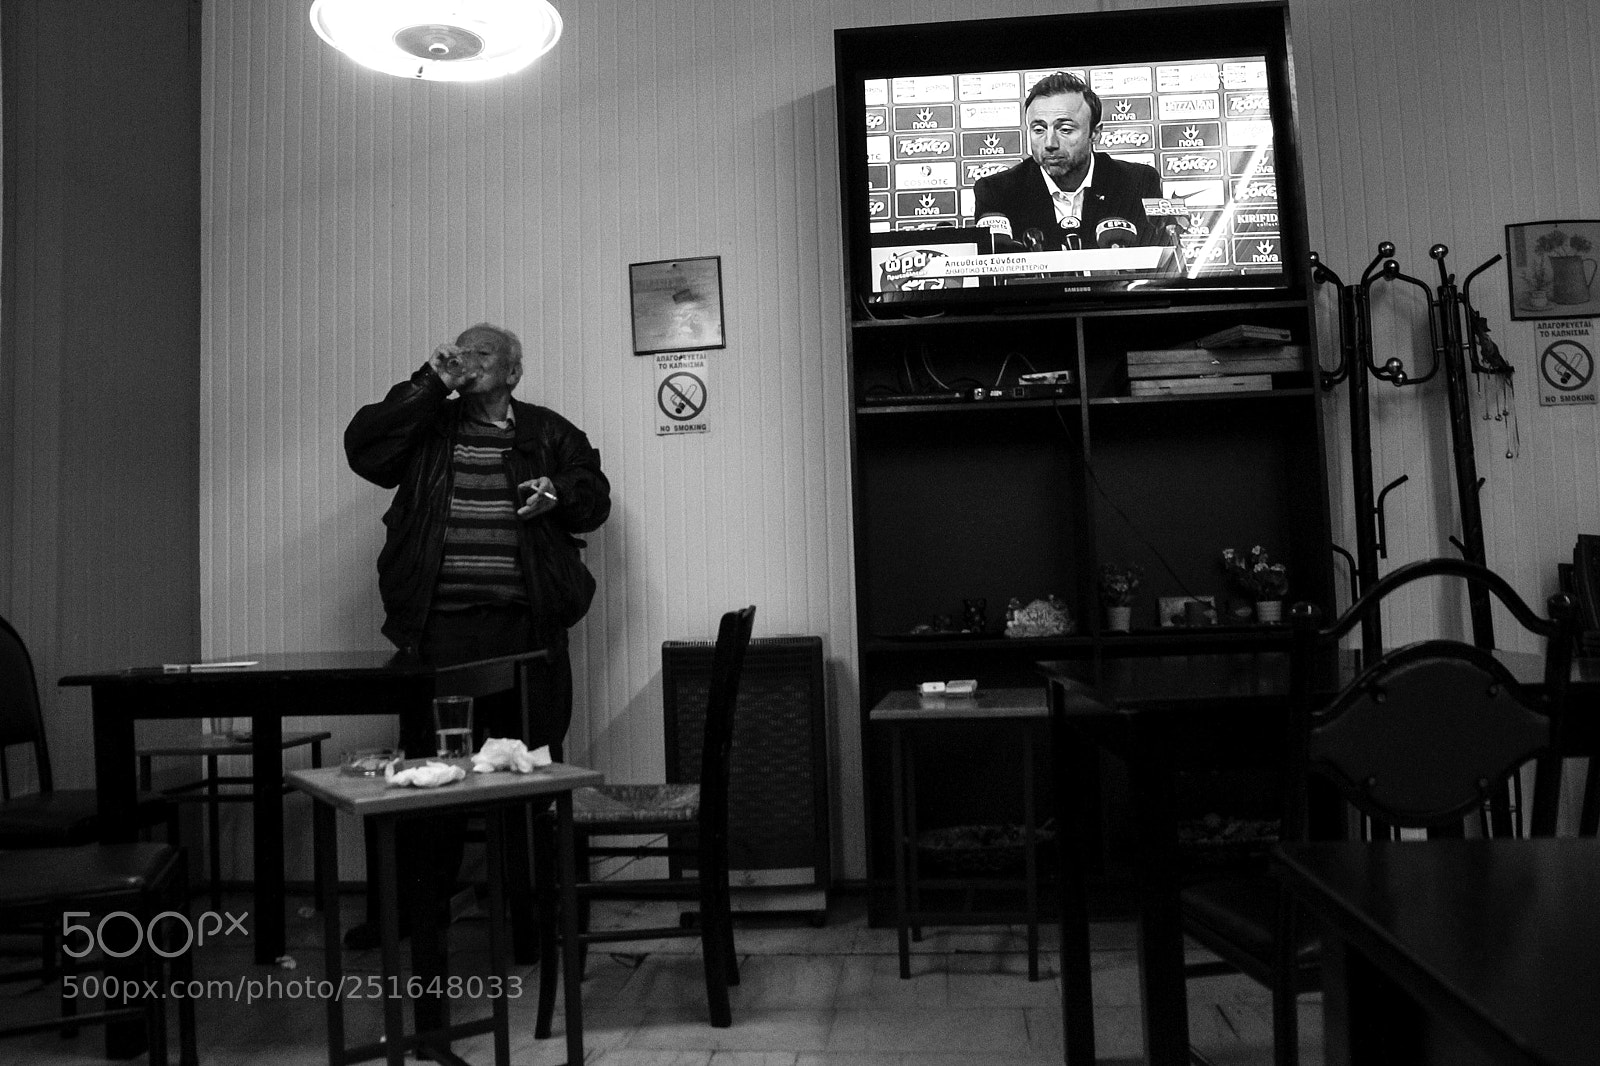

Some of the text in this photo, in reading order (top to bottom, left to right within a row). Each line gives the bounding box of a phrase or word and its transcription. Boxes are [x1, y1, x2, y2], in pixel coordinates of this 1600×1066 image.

[1111, 112, 1136, 121] nova
[912, 120, 938, 129] nova
[1178, 137, 1204, 147] nova
[979, 145, 1005, 155] nova
[915, 206, 940, 216] nova
[991, 256, 1026, 265] Σύνδεση
[1252, 254, 1279, 262] nova
[1538, 321, 1591, 329] ΑΠΑΓΟΡΕΥΕΤΑΙ
[1540, 329, 1590, 338] ΤΟ ΚΑΠΝΙΣΜΑ
[669, 361, 704, 369] ΚΑΠΝΙΣΜΑ
[1560, 394, 1595, 402] SMOKING
[674, 423, 707, 431] SMOKING
